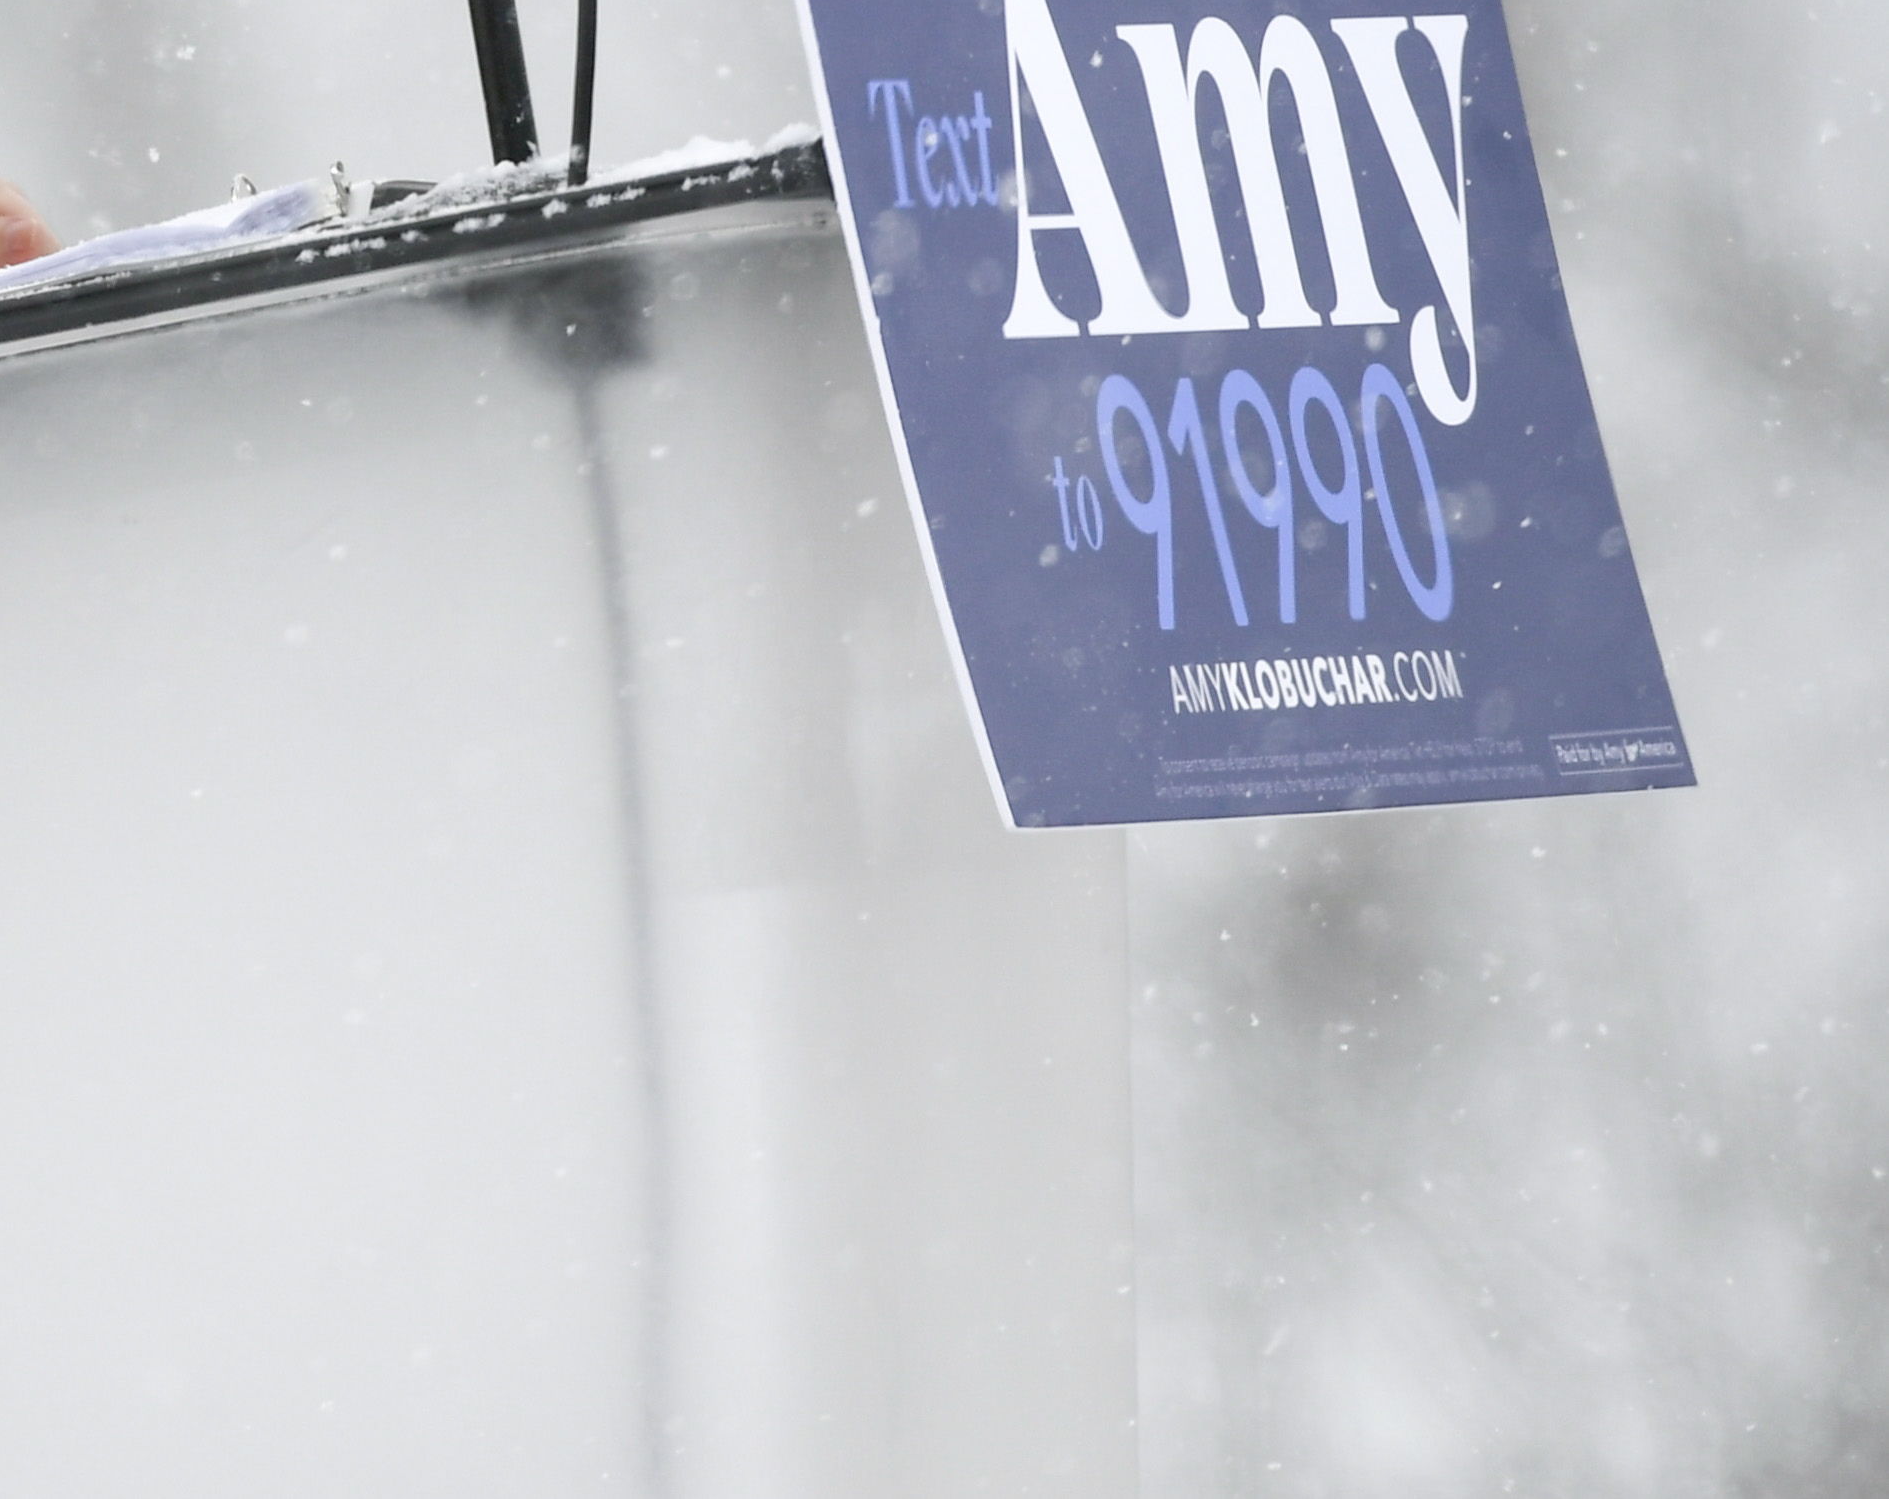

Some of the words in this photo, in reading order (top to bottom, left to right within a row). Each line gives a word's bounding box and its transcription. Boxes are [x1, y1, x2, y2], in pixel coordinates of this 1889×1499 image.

[867, 79, 999, 209] Text
[1053, 455, 1103, 552] to
[1096, 364, 1454, 629] 91990
[1170, 650, 1462, 714] AMYKLOBUCHAR.COM
